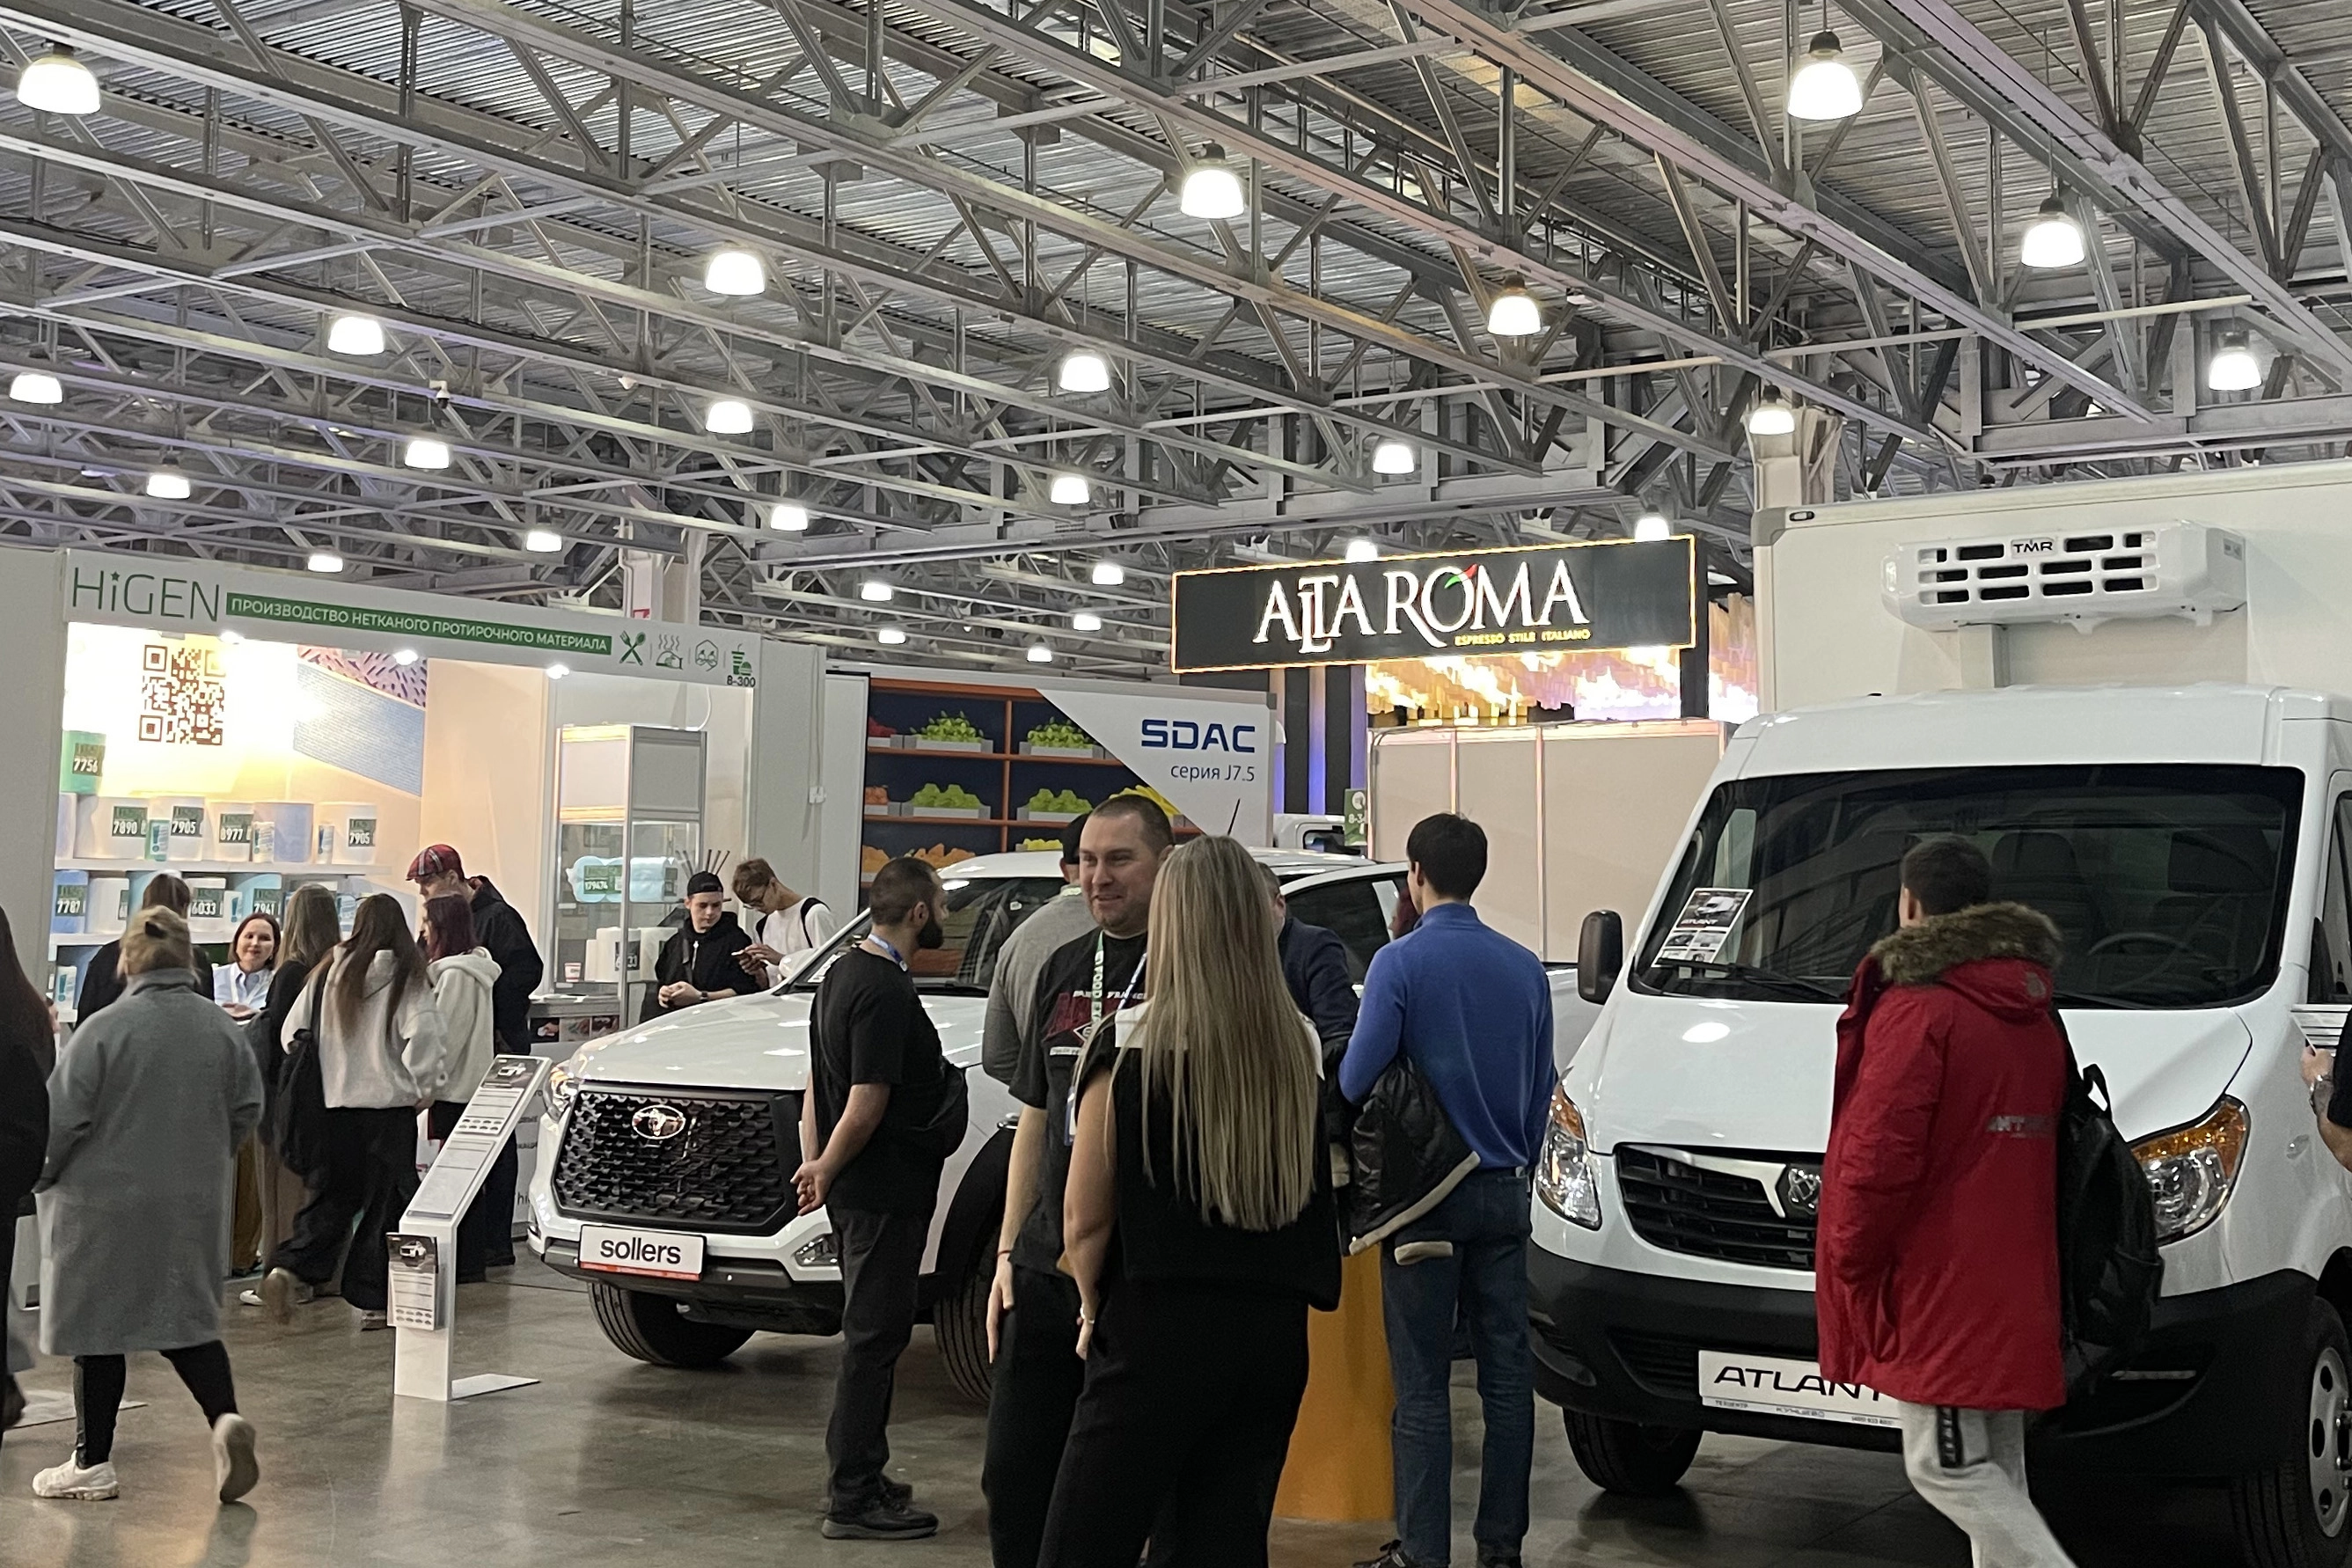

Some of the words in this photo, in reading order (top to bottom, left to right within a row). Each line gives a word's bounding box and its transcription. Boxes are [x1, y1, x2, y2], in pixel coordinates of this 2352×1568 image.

[2012, 539, 2053, 553] TMR
[72, 566, 220, 622] HiGEN
[1382, 558, 1591, 648] ROMA
[231, 597, 349, 623] ПРОИЗВОДСТВО
[352, 612, 429, 632] НЕТКАНОГО
[432, 620, 534, 642] ПРОТИРОЧНОГО
[537, 633, 608, 651] МАТЕРИАЛА
[1454, 633, 1506, 647] ESPRESSO
[1508, 631, 1536, 643] STILE
[1542, 628, 1592, 641] ITALIANO
[1141, 719, 1256, 753] SDAC
[73, 758, 99, 773] 7756
[1170, 765, 1220, 783] серия
[1224, 764, 1256, 782] J7.5
[172, 820, 196, 834] 7905
[600, 1236, 681, 1264] sollers
